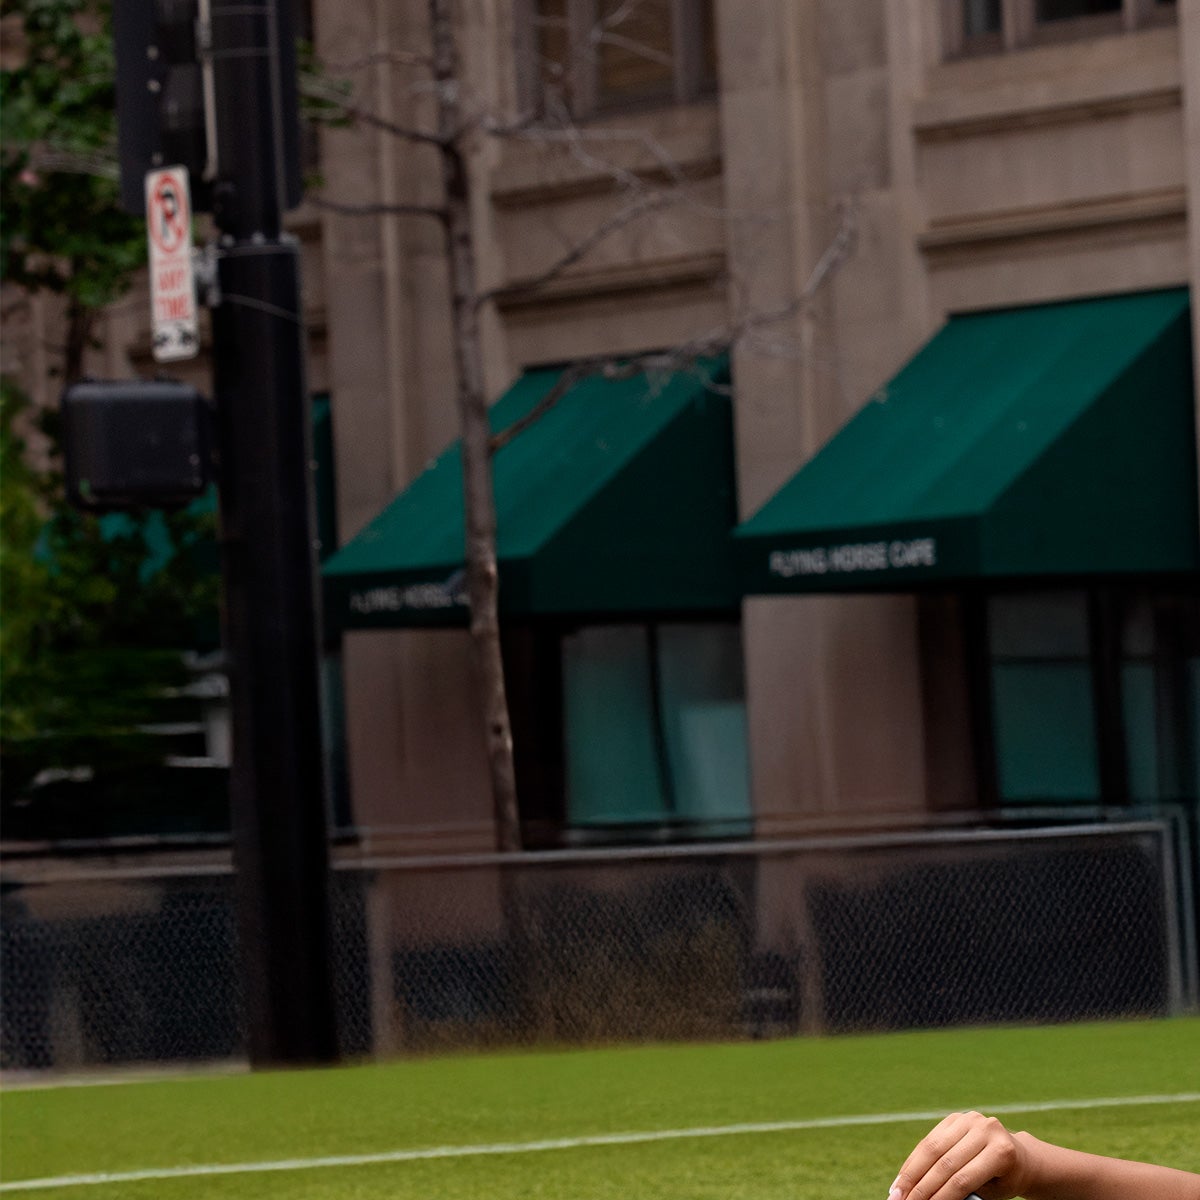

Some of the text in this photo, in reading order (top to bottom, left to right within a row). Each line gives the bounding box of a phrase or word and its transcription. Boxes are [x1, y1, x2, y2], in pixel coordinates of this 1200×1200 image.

[769, 537, 936, 577] FLYING HORSE CAFE
